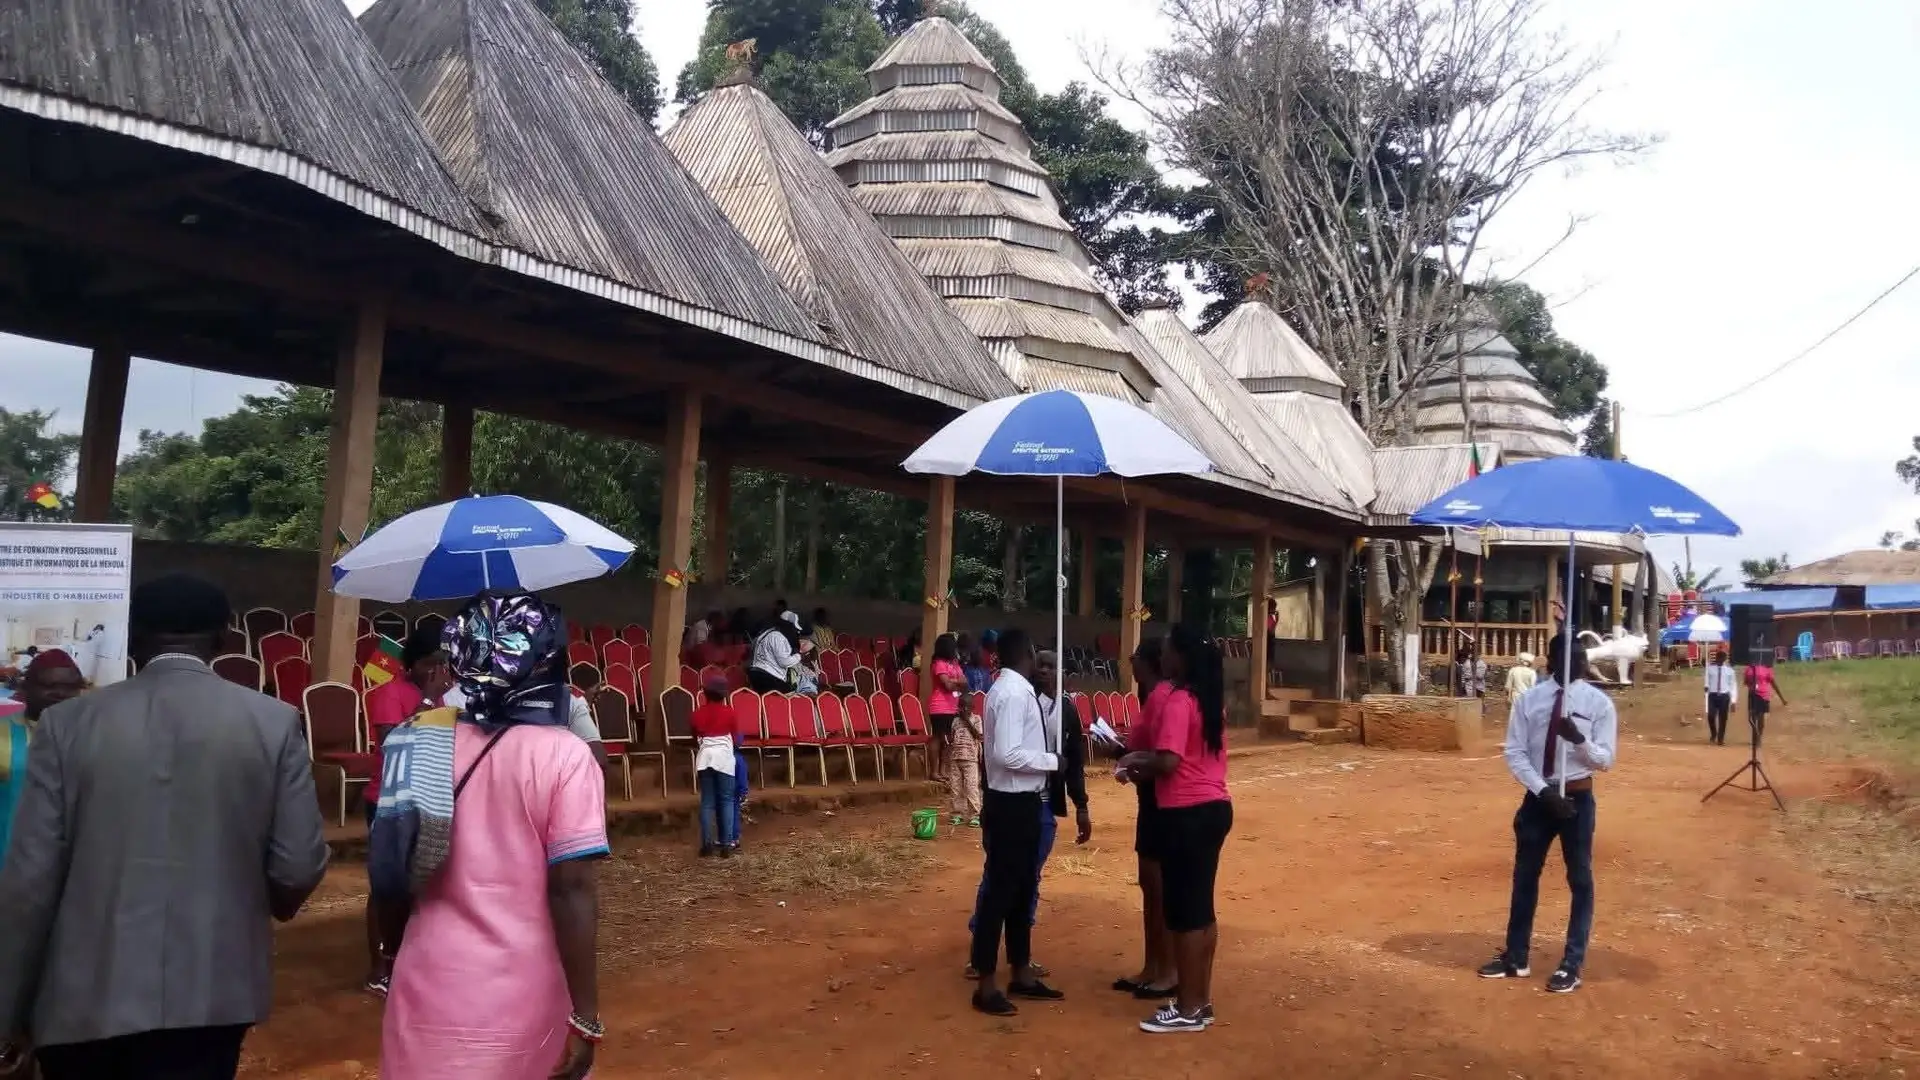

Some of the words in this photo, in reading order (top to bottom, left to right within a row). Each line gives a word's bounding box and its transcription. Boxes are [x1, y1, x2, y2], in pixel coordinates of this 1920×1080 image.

[13, 545, 22, 554] DE
[23, 545, 60, 555] FORMATION
[60, 546, 118, 556] PROFESSIONNELLE
[25, 559, 33, 568] ET
[34, 559, 79, 568] INFORMATIQUE
[80, 559, 90, 568] DE
[90, 559, 98, 568] LA
[2, 592, 51, 600] INDUSTRIE
